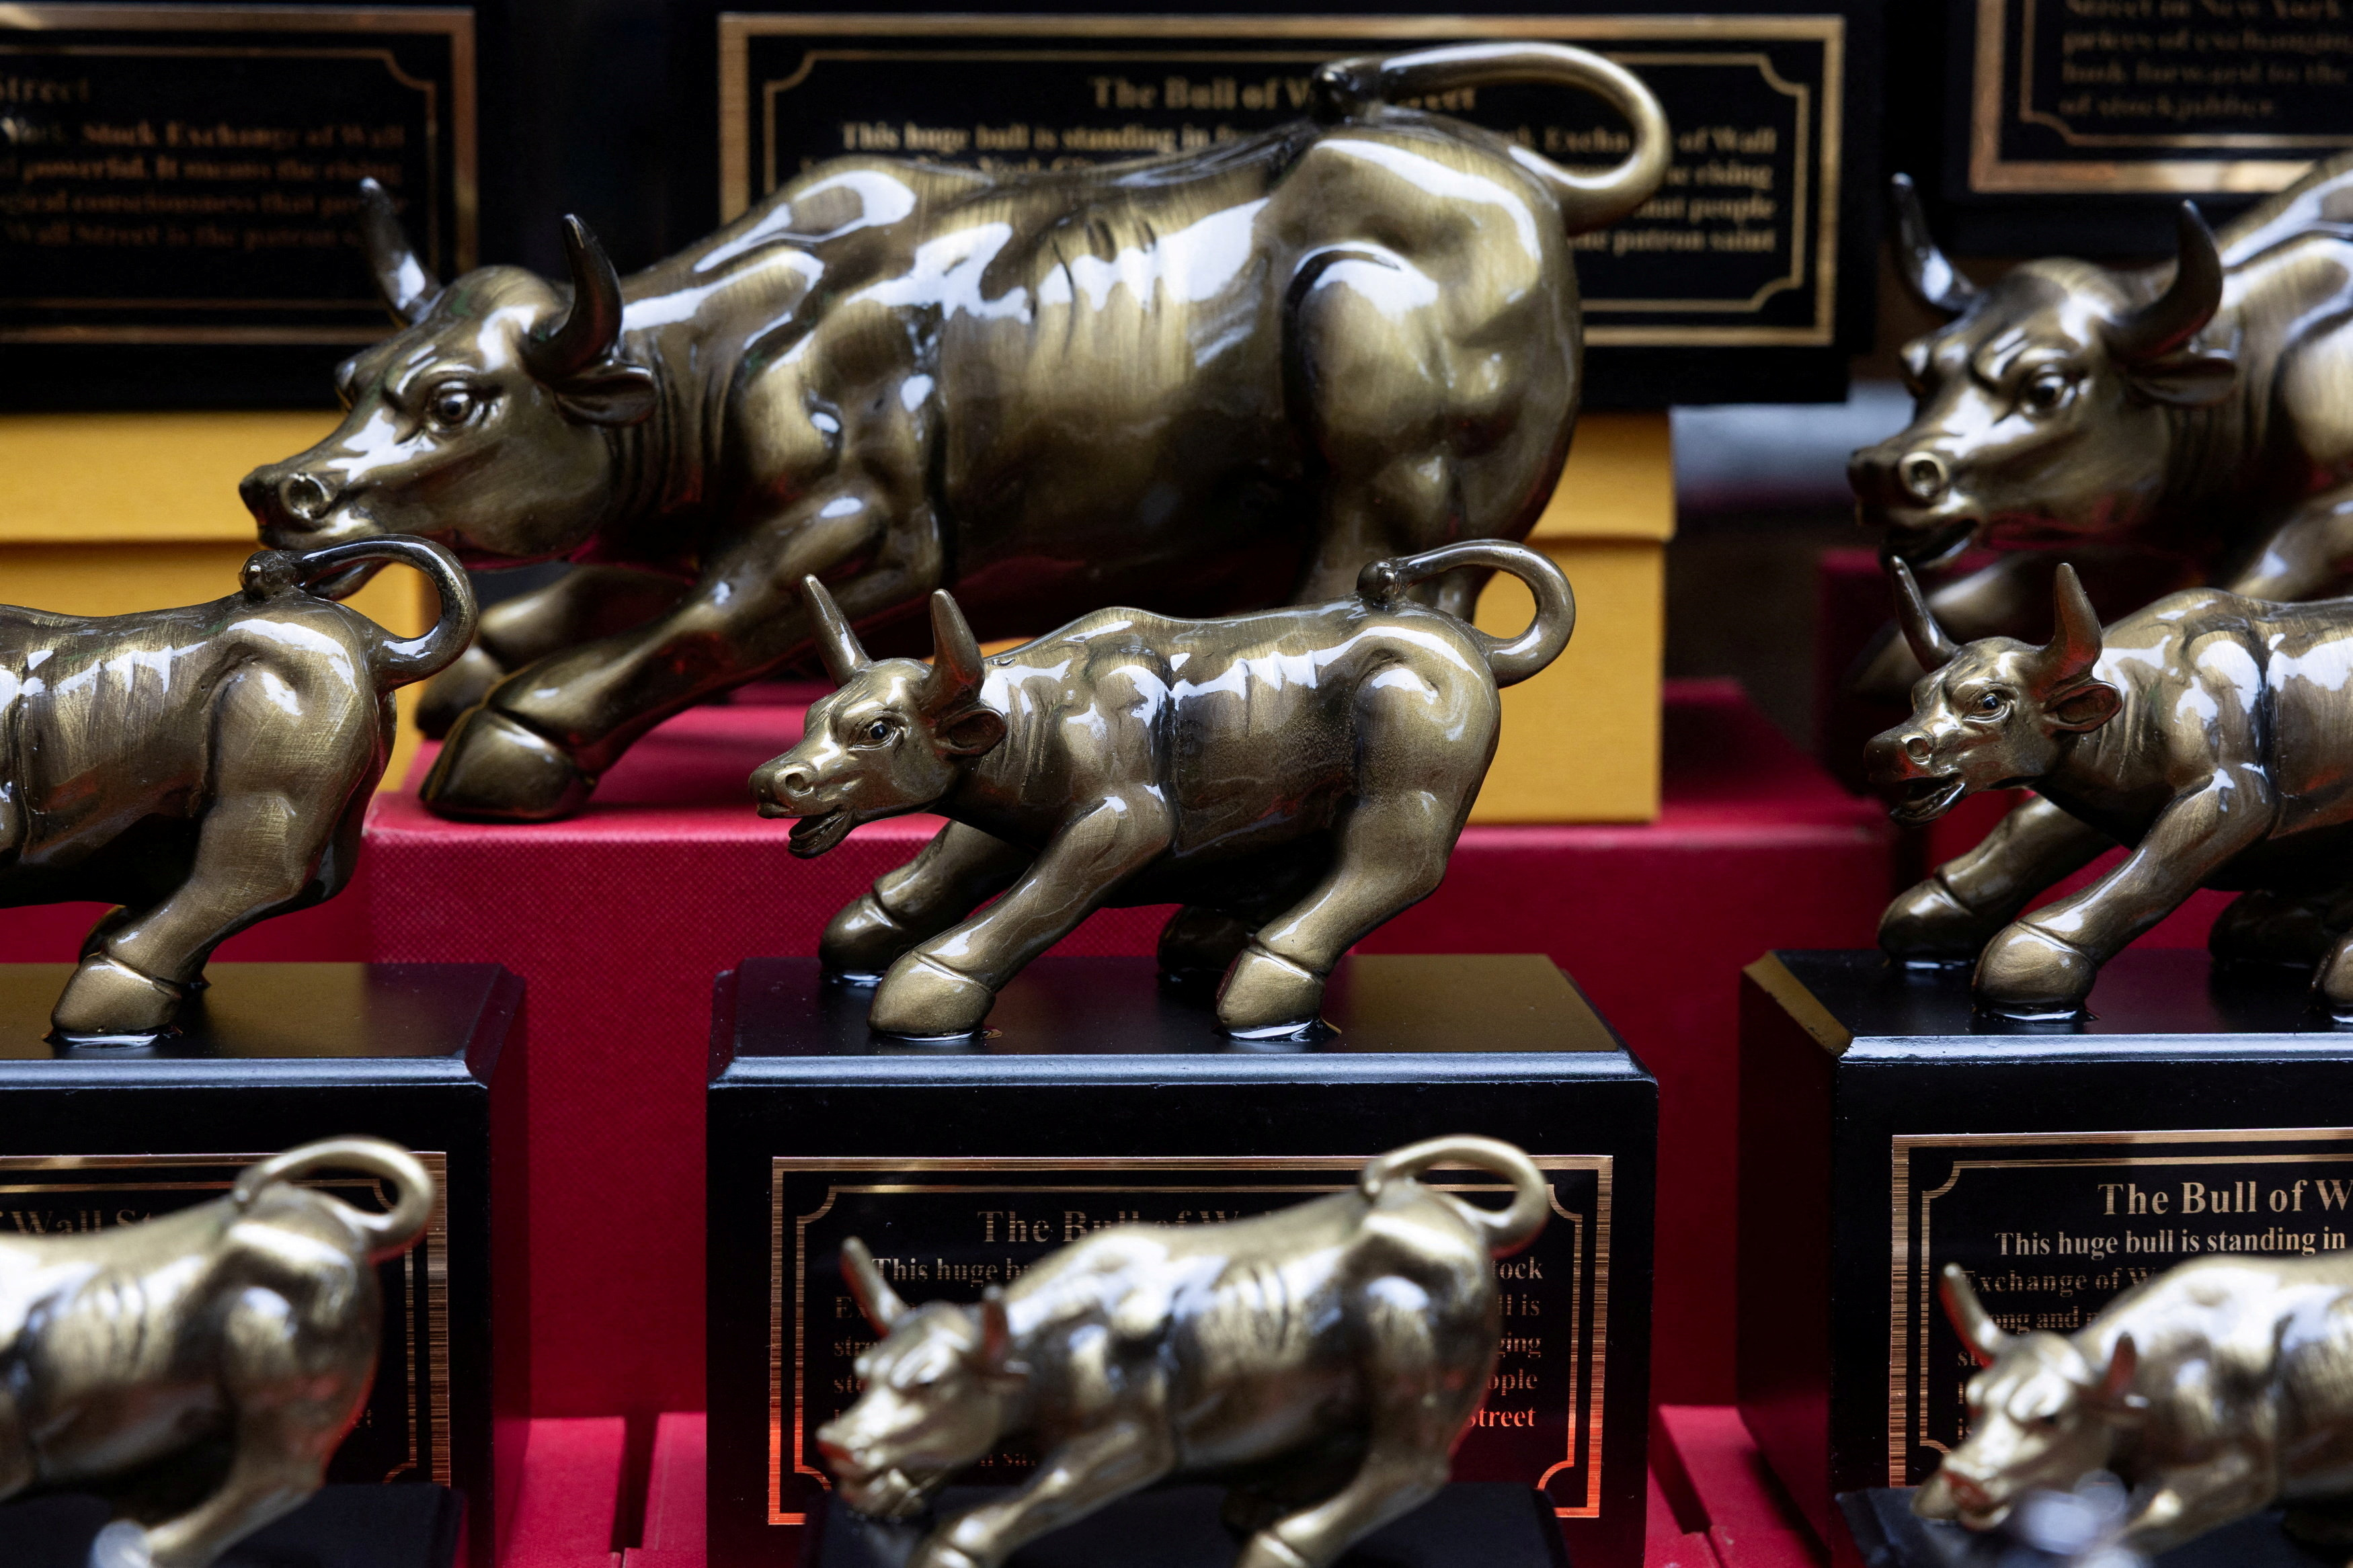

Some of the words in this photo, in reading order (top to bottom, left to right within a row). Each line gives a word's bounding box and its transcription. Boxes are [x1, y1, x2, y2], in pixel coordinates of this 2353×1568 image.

[1089, 76, 1158, 110] The
[1163, 76, 1238, 110] Bull
[1240, 76, 1281, 110] of
[841, 121, 902, 151] This
[904, 122, 971, 155] huge
[974, 122, 1030, 151] bull
[1033, 124, 1058, 151] is
[1060, 123, 1177, 156] standing
[1708, 126, 1778, 155] Wall
[2097, 1183, 2169, 1215] The
[2180, 1181, 2258, 1214] Bull
[2268, 1179, 2309, 1212] of
[976, 1210, 1050, 1243] The
[1994, 1231, 2050, 1256] This
[2057, 1231, 2119, 1261] huge
[2124, 1229, 2175, 1253] bull
[2181, 1229, 2201, 1252] is
[2206, 1226, 2317, 1256] standing
[2321, 1226, 2347, 1249] in
[871, 1257, 928, 1282] This
[936, 1257, 998, 1287] huge
[2094, 1267, 2123, 1292] of
[1521, 1292, 1542, 1317] is
[2035, 1306, 2080, 1329] and
